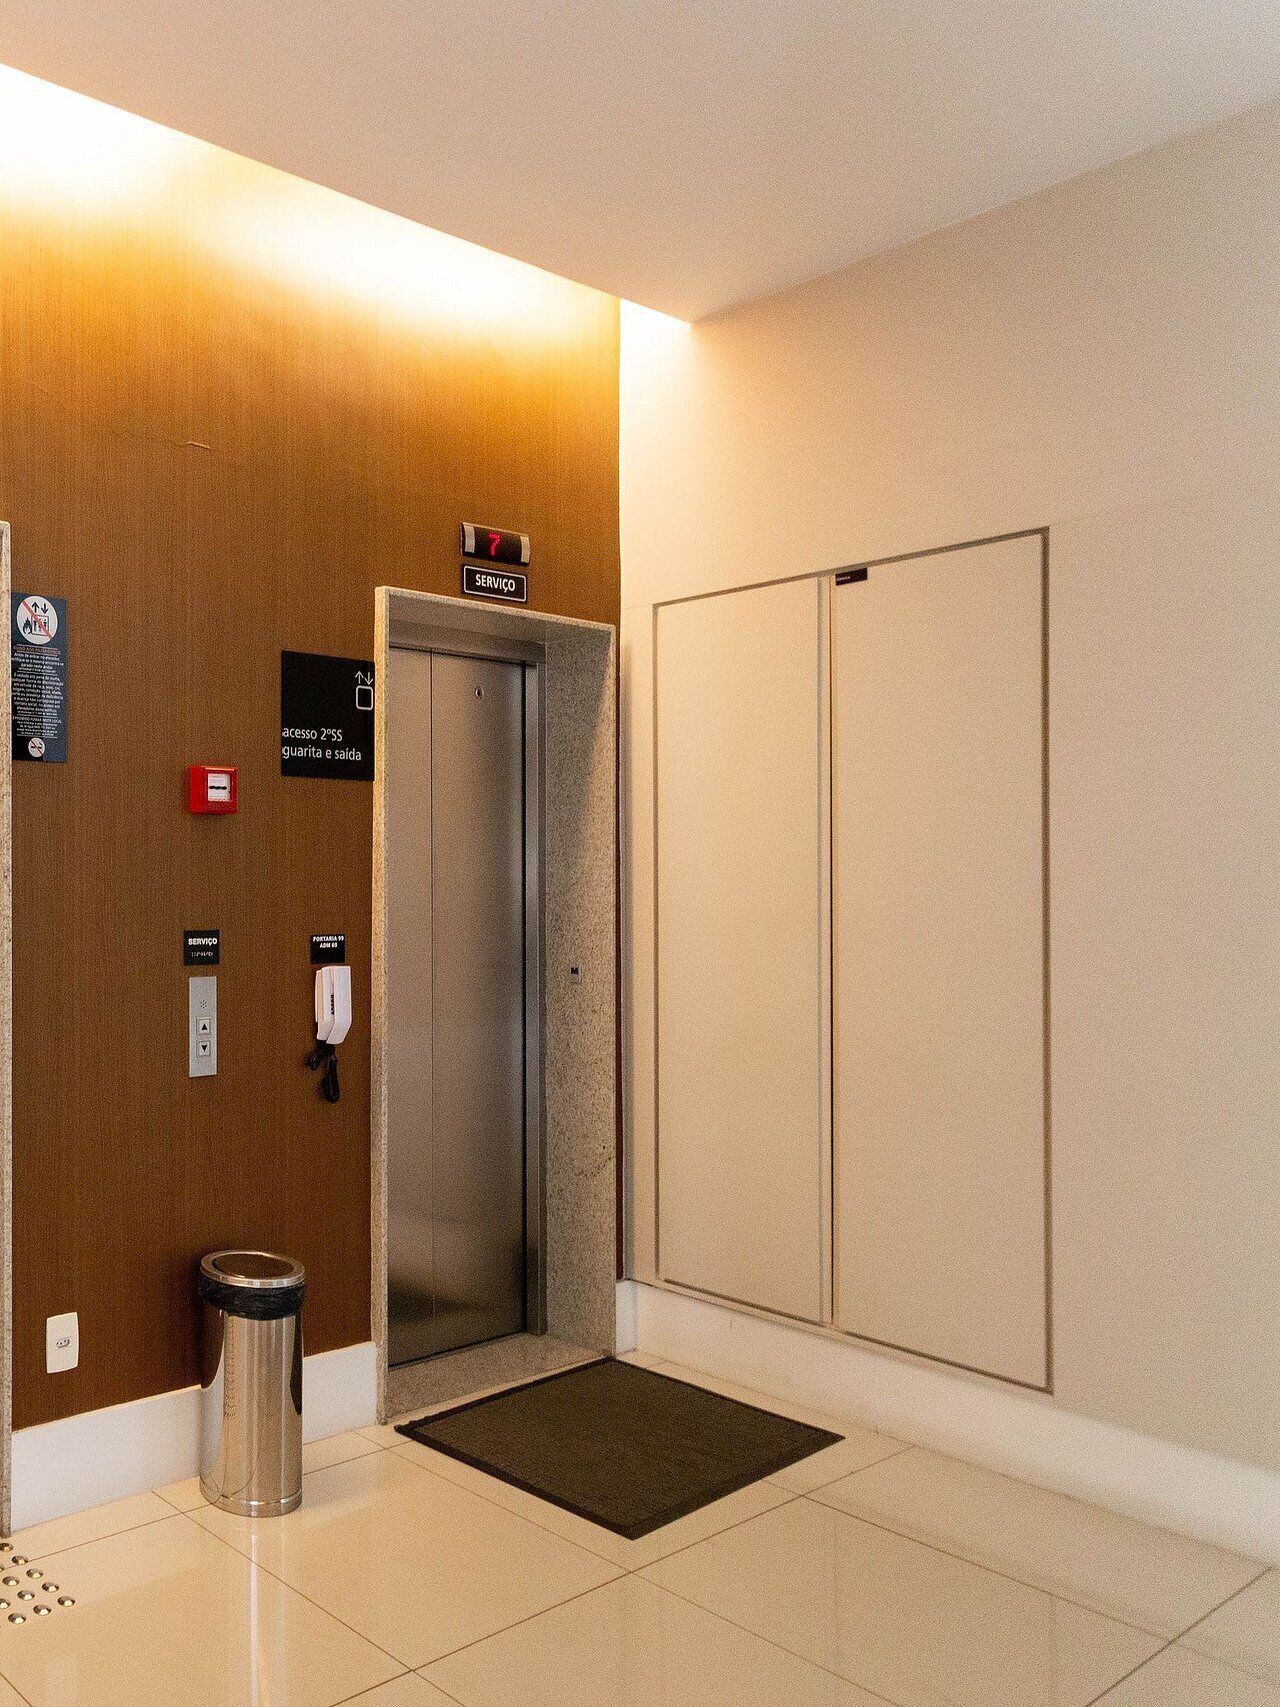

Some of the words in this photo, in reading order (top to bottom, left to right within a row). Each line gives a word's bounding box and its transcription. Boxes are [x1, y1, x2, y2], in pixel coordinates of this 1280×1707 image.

[488, 532, 501, 556] 7
[475, 573, 516, 593] SERVIÇO
[282, 727, 318, 740] acesso
[282, 744, 322, 759] guarita
[325, 749, 332, 759] e
[334, 747, 362, 760] saída
[188, 937, 218, 946] SERVIÇO
